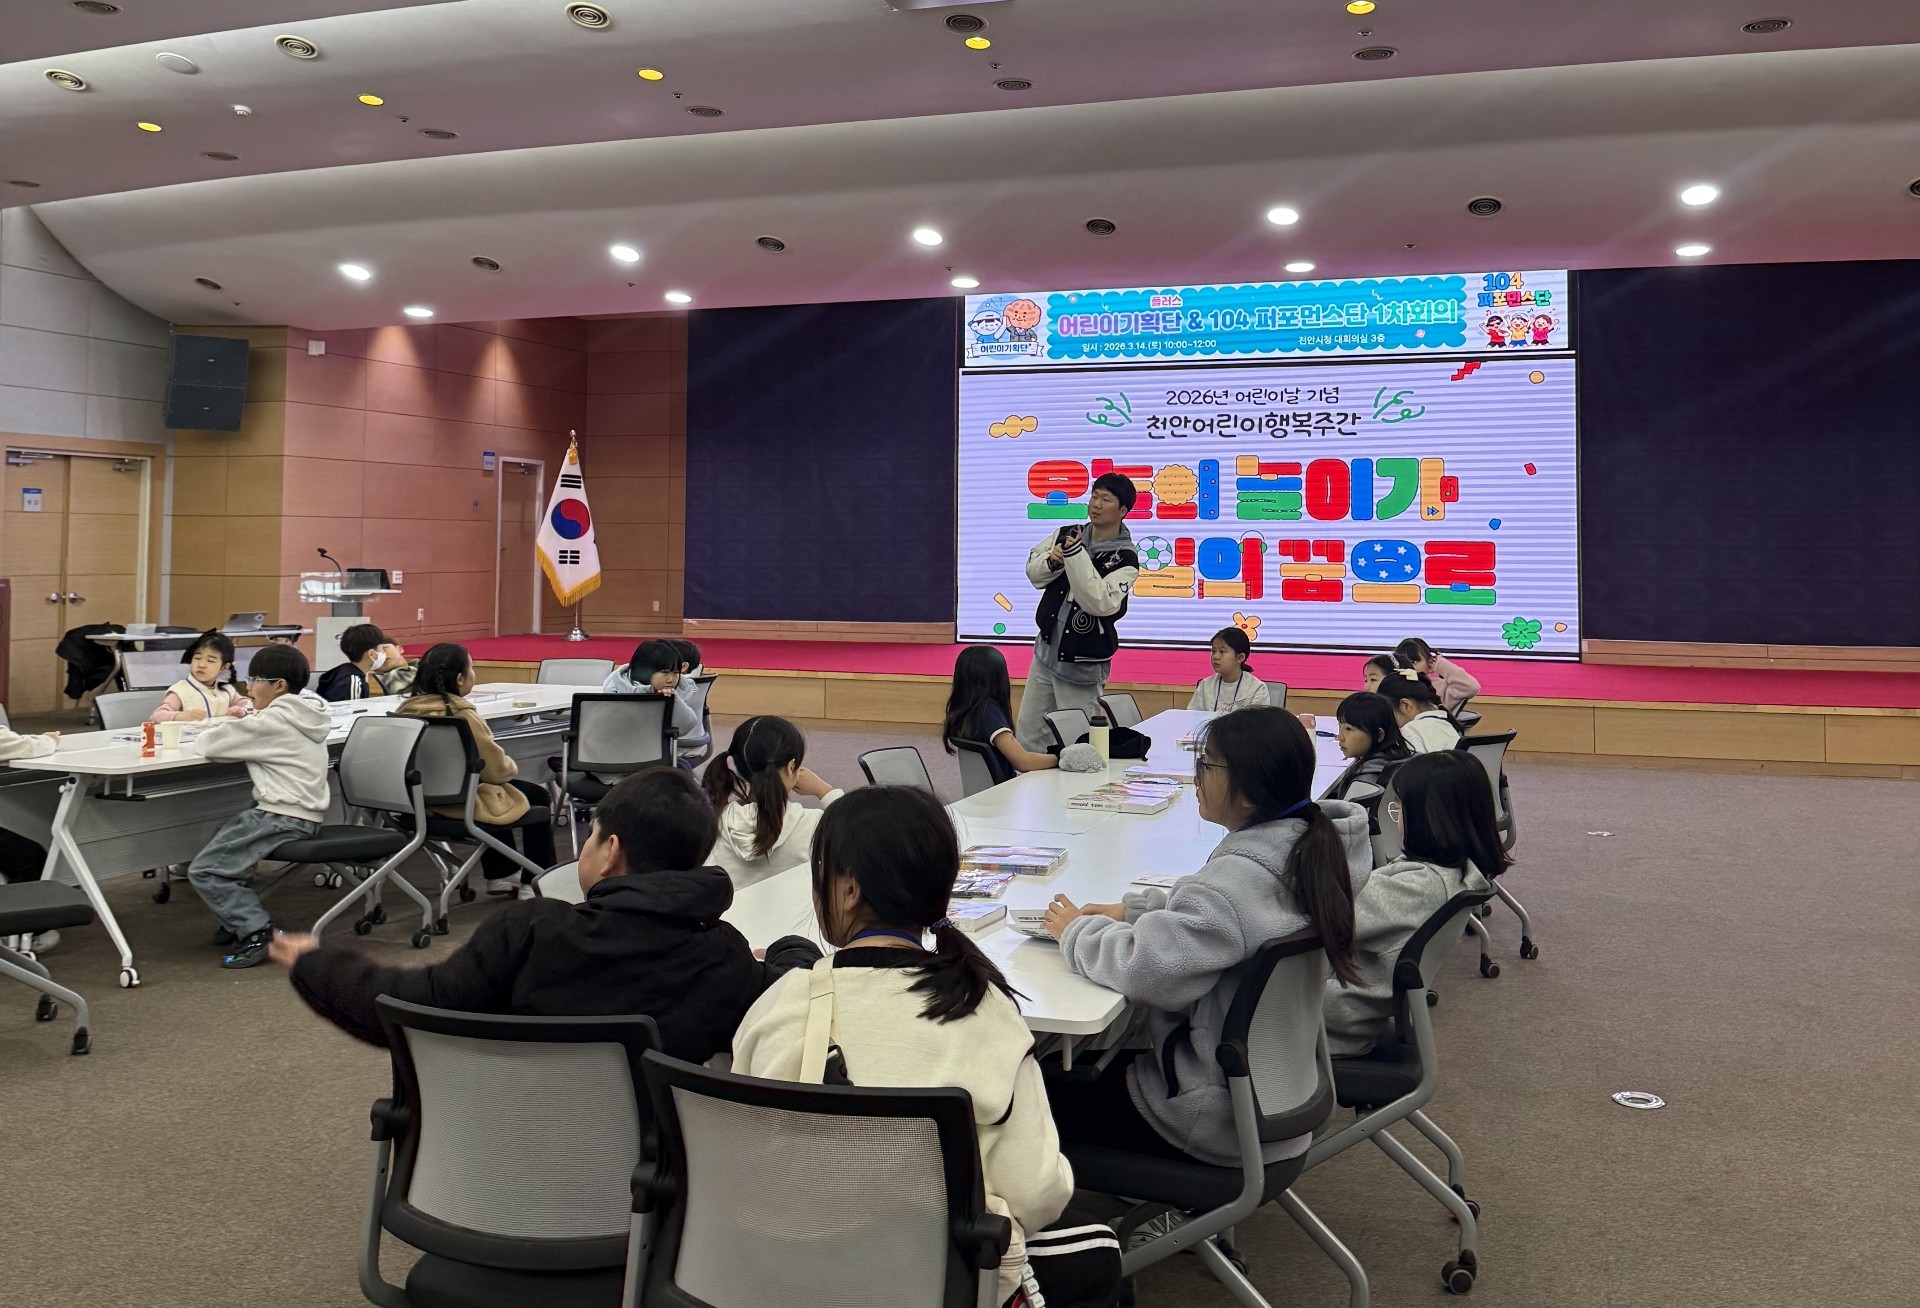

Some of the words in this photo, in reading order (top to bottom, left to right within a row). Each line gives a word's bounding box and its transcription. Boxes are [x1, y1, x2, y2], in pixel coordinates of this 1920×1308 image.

[1483, 272, 1524, 291] 104
[1150, 295, 1183, 308] 플러스
[1477, 290, 1552, 307] 퍼포먼스단
[1058, 311, 1183, 337] 어린이기획단
[1187, 310, 1204, 332] &
[1209, 309, 1250, 330] 104
[1254, 302, 1368, 330] 퍼포먼스단
[1373, 299, 1458, 325] 1차회의
[1082, 343, 1098, 352] 일시
[1164, 339, 1217, 349] 10:00~12:00
[1299, 334, 1332, 345] 천안시청
[1334, 333, 1368, 344] 대회의실
[1166, 389, 1228, 405] 2026년
[1235, 387, 1301, 405] 어린이날
[1307, 386, 1340, 405] 기념
[1146, 411, 1362, 439] 천안어린이행복주간
[1235, 455, 1459, 521] 놀이가
[1132, 531, 1268, 600] 일의
[1278, 538, 1497, 605] 꿈으로
